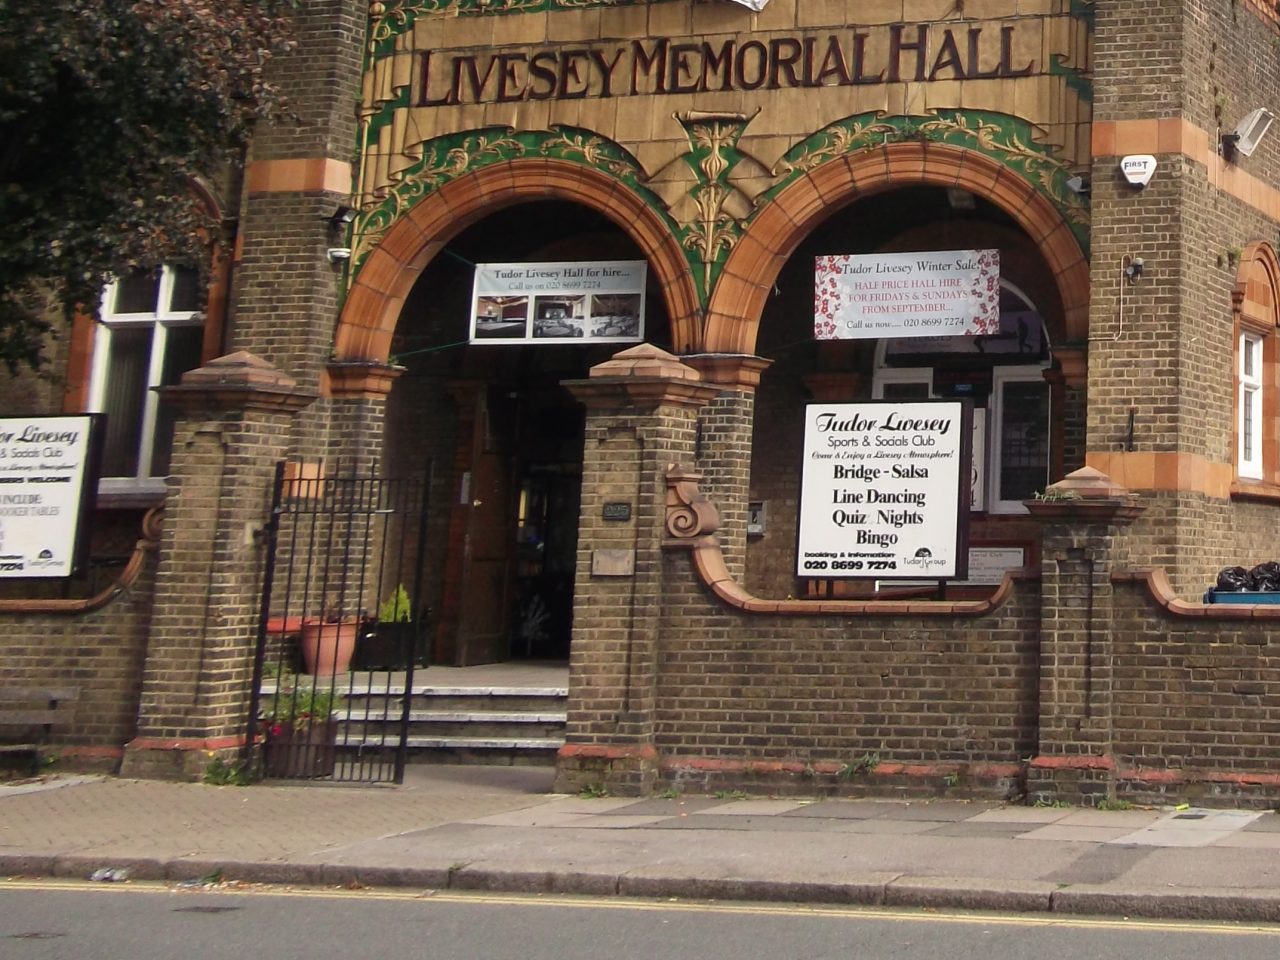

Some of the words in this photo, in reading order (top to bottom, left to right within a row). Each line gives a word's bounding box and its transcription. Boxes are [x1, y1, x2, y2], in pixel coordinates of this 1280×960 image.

[417, 48, 623, 108] LIVESEY
[631, 31, 885, 94] MEMORIAL
[887, 24, 1035, 83] HALL
[1123, 160, 1149, 170] FIRST
[494, 269, 523, 279] Tudor
[525, 268, 560, 280] Livesey
[563, 268, 583, 278] Hall
[586, 267, 600, 277] for
[842, 263, 872, 275] Tudor
[875, 263, 913, 275] Livesey
[917, 261, 952, 271] Winter
[508, 281, 524, 290] Call
[546, 281, 560, 290] 020
[583, 280, 601, 289] 7274
[854, 281, 879, 290] HALF
[881, 280, 909, 290] PRICE
[911, 279, 936, 289] HALL
[939, 278, 962, 287] HIRE
[849, 294, 868, 303] FOR
[869, 292, 910, 302] FRIDAYS
[912, 292, 920, 301] &
[922, 290, 968, 300] SUNDAYS
[862, 305, 889, 314] FROM
[846, 320, 863, 329] Call
[903, 319, 920, 328] 020
[921, 318, 942, 327] 8699
[944, 317, 965, 326] 7274
[815, 412, 877, 433] Tudor
[878, 411, 951, 435] Livesey
[16, 425, 79, 447] Livesey
[827, 435, 859, 449] Sports
[862, 435, 871, 447] &
[875, 434, 908, 447] Socials
[912, 434, 935, 447] Club
[841, 450, 865, 461] Enjoy
[873, 450, 901, 461] Livesey
[833, 464, 881, 483] Bridge
[891, 463, 929, 479] Salsa
[832, 489, 864, 504] Line
[865, 488, 926, 507] Dancing
[832, 509, 867, 527] Quiz
[876, 509, 924, 528] Nights
[856, 529, 898, 548] Bingo
[804, 551, 838, 559] booking
[804, 560, 828, 570] 020
[831, 560, 863, 570] 8699
[867, 560, 897, 570] 7274
